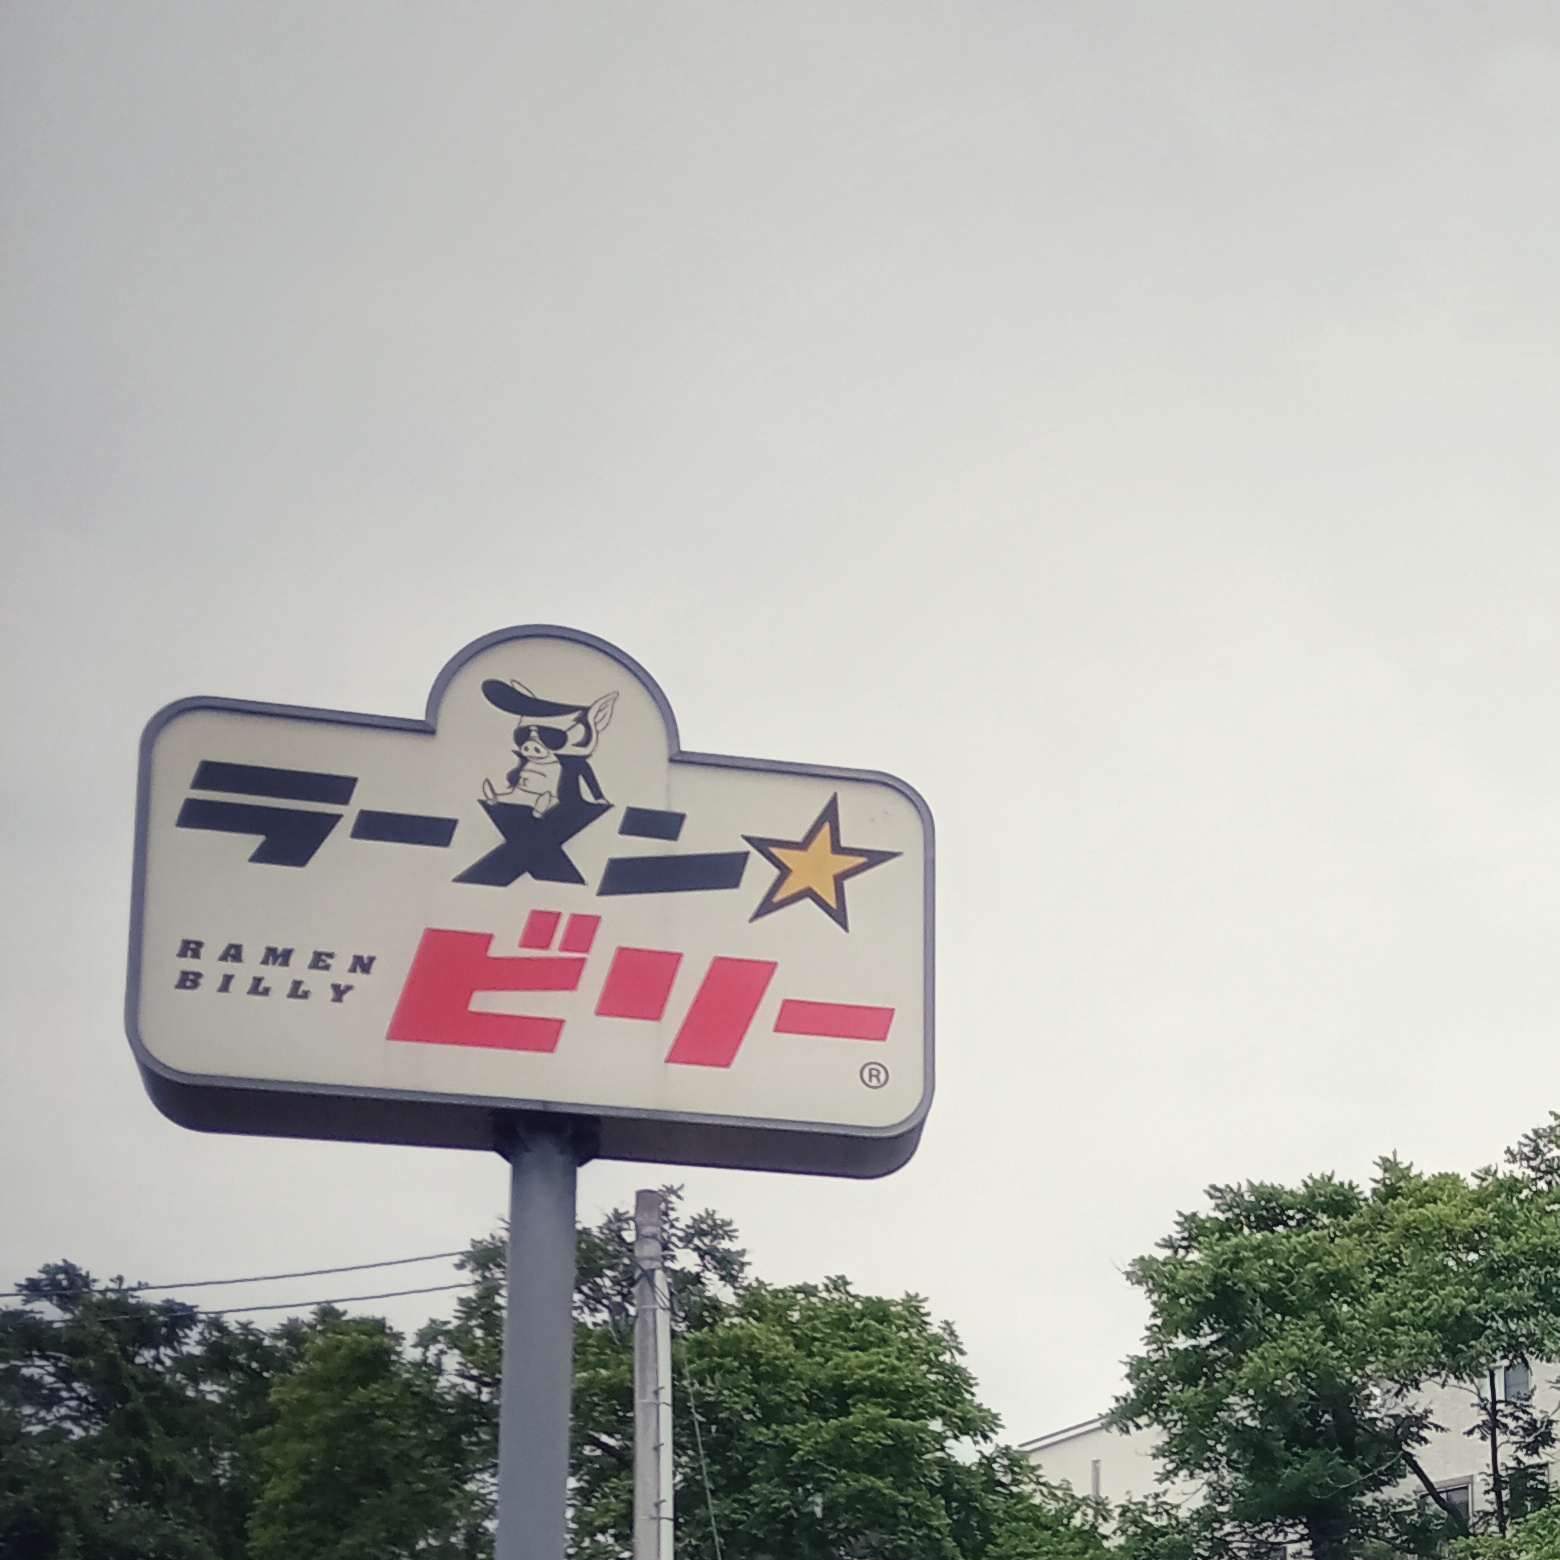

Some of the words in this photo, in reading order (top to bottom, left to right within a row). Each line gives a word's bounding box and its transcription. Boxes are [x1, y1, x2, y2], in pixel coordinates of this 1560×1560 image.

[175, 760, 750, 896] ラーメン
[174, 970, 355, 1003] BILLY
[176, 938, 377, 975] RAMEN
[386, 909, 896, 1068] ビリー
